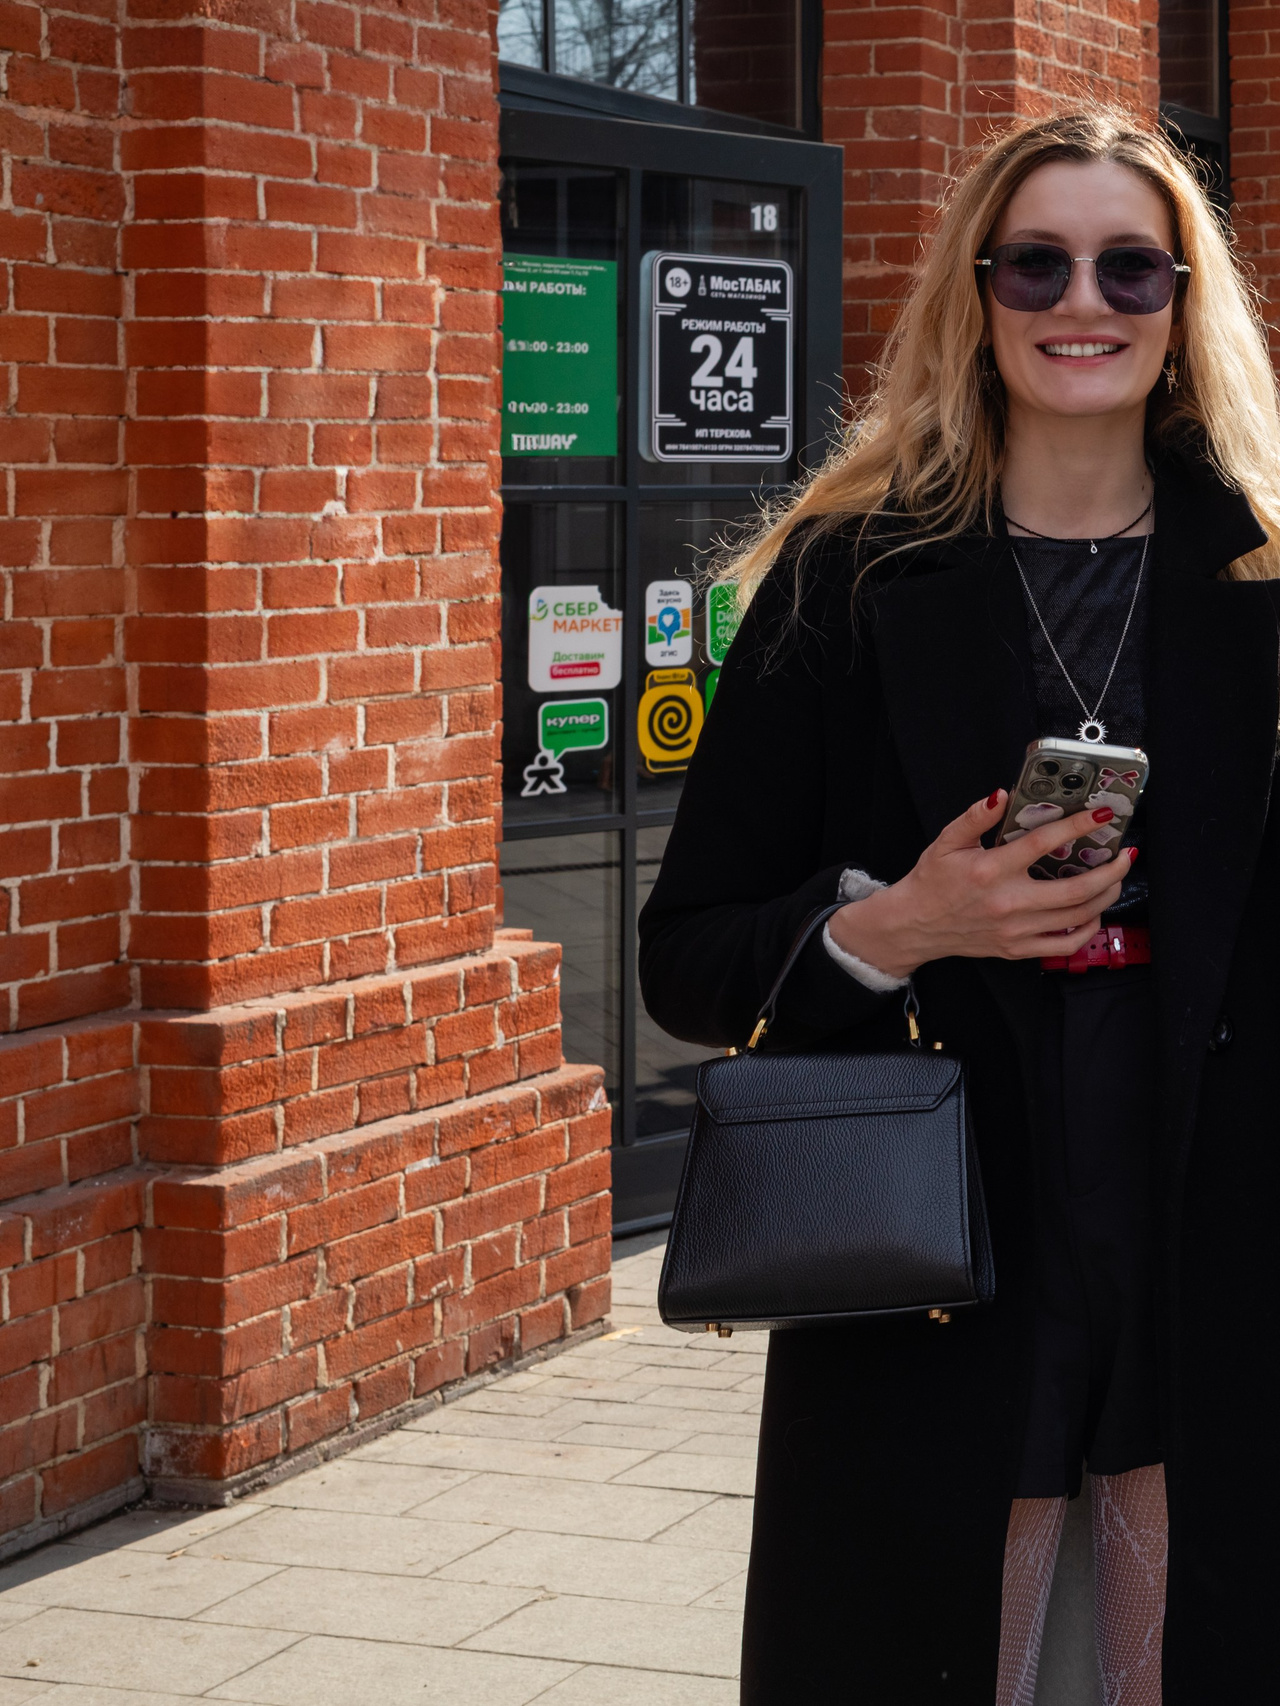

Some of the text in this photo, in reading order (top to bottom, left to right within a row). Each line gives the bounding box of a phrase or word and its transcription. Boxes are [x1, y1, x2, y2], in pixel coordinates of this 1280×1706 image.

[751, 204, 777, 231] 18
[529, 281, 587, 296] РАБОТЫ:
[669, 276, 689, 288] 18+
[710, 275, 782, 294] МосТАБАК
[727, 292, 766, 300] МАГАЗИНОВ
[681, 318, 766, 334] РЕЖИМ РАБОТЫ
[556, 342, 589, 354] 23:00
[690, 334, 758, 388] 24
[690, 389, 754, 412] часа
[556, 403, 589, 414] 23:00
[695, 428, 752, 439] ИП ТЕРЕХОВА
[553, 602, 599, 616] СБЕР
[553, 618, 622, 633] МАРКЕТ
[552, 651, 605, 662] Доставим
[552, 665, 599, 676] бесплатно
[546, 714, 601, 728] купер
